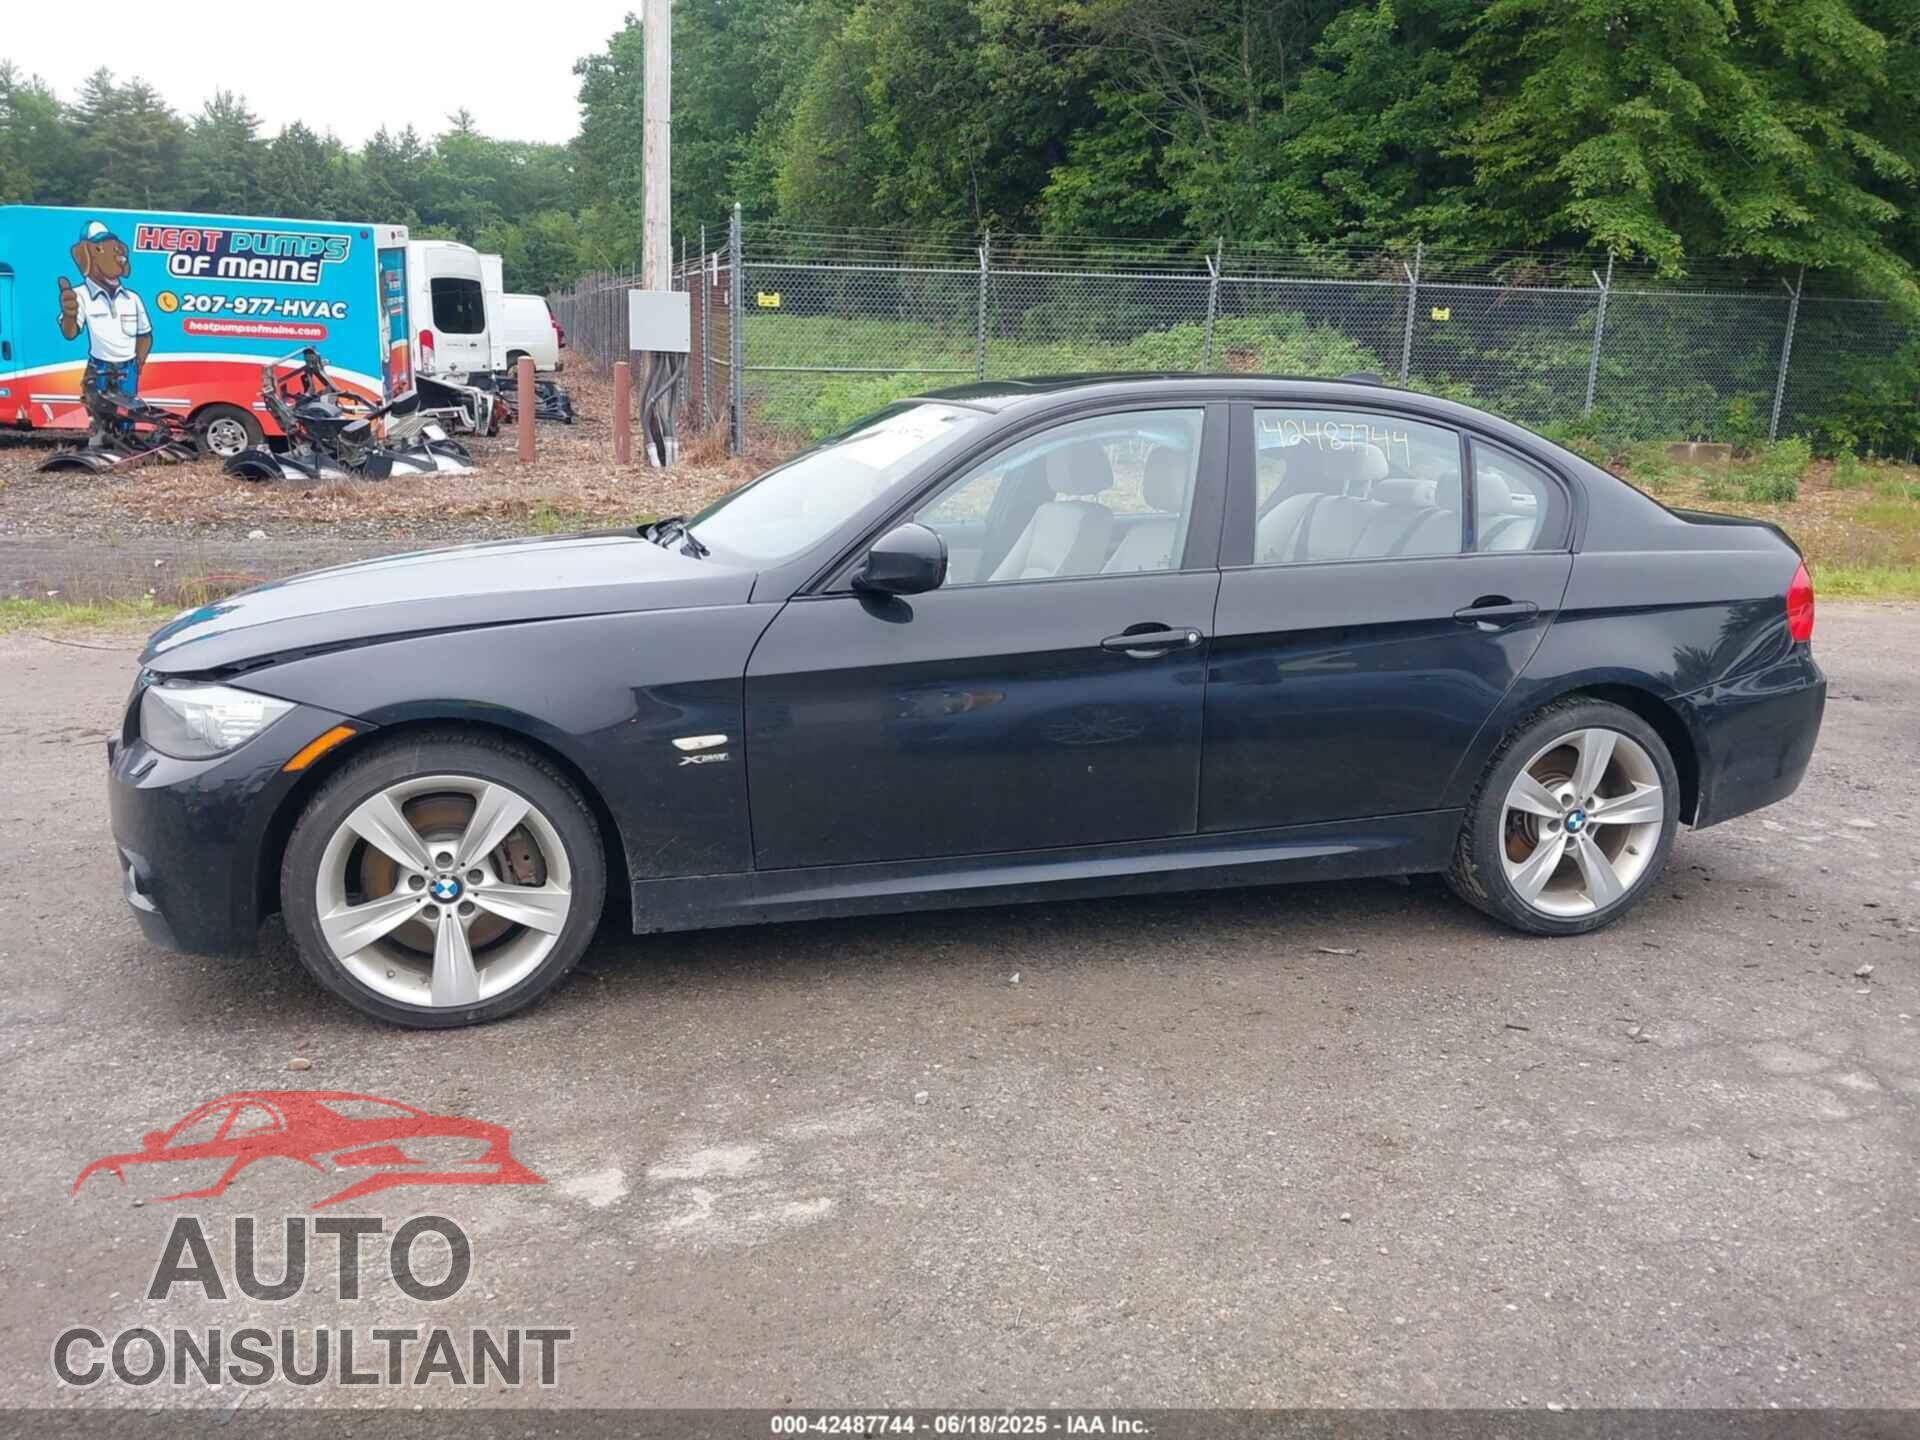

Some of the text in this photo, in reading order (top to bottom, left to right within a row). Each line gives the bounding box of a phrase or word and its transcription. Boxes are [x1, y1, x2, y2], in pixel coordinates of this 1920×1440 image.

[138, 228, 347, 259] HEAT PUMPS
[171, 254, 319, 281] OF MAINE
[181, 294, 347, 319] 207-977-HVAC
[188, 320, 322, 337] heatpumpsofmaine.com
[1262, 419, 1411, 468] 42487744
